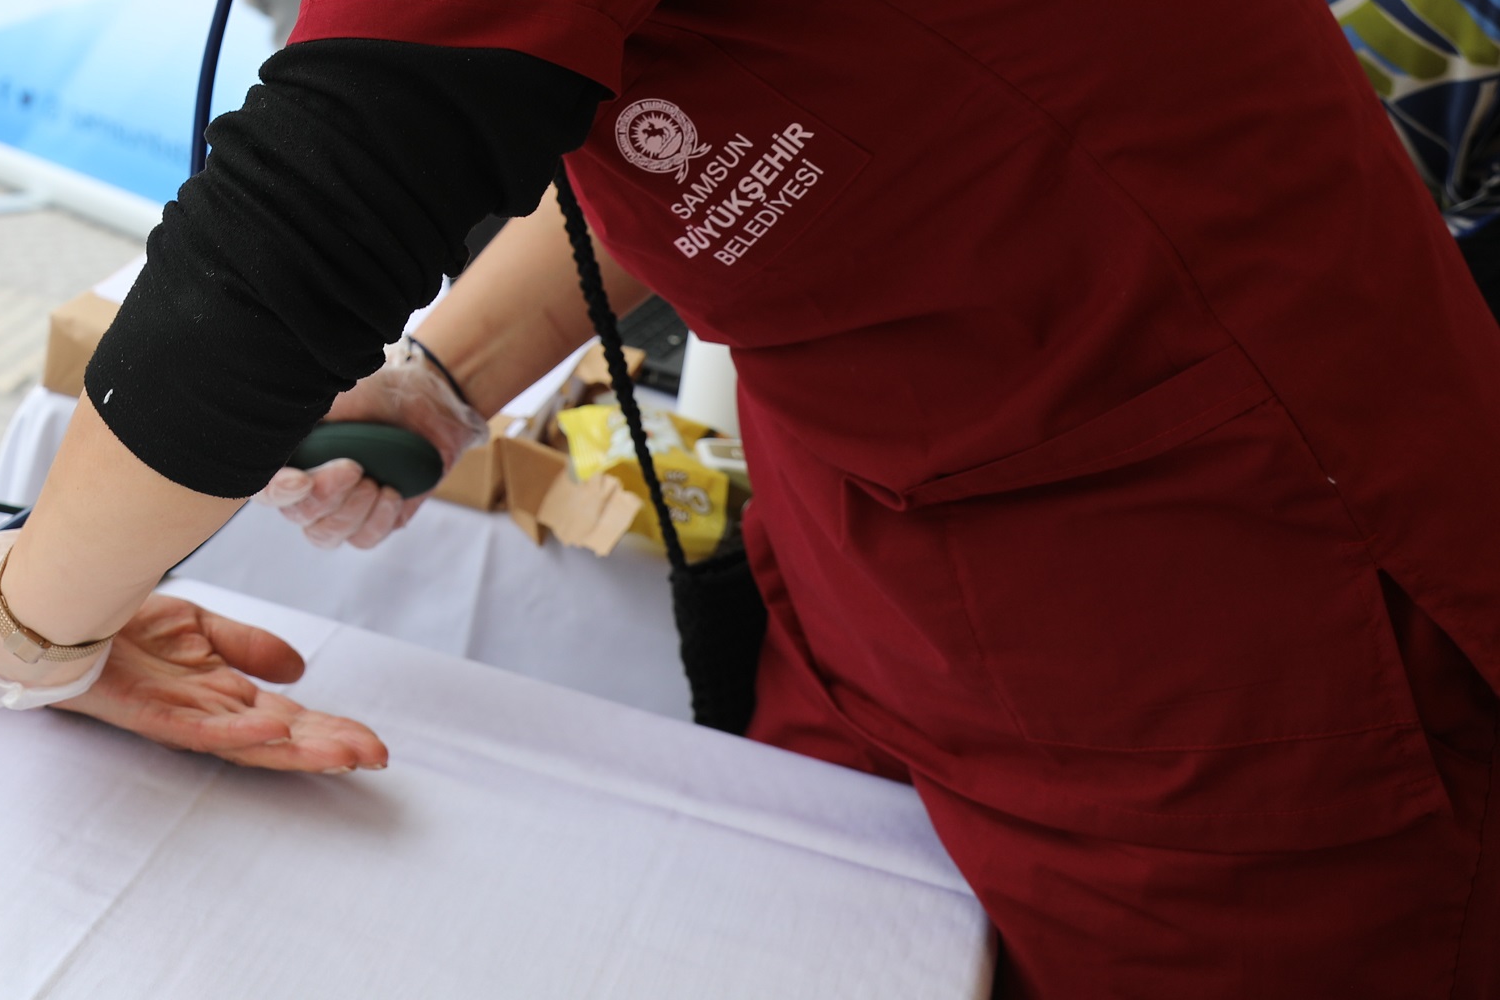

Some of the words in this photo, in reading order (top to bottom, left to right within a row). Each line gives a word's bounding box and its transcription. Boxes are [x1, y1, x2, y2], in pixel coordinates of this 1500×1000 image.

[671, 133, 753, 220] SAMSUN
[673, 122, 815, 258] BÜYÜKŞEHİR
[713, 158, 824, 266] BELEDİYESİ
